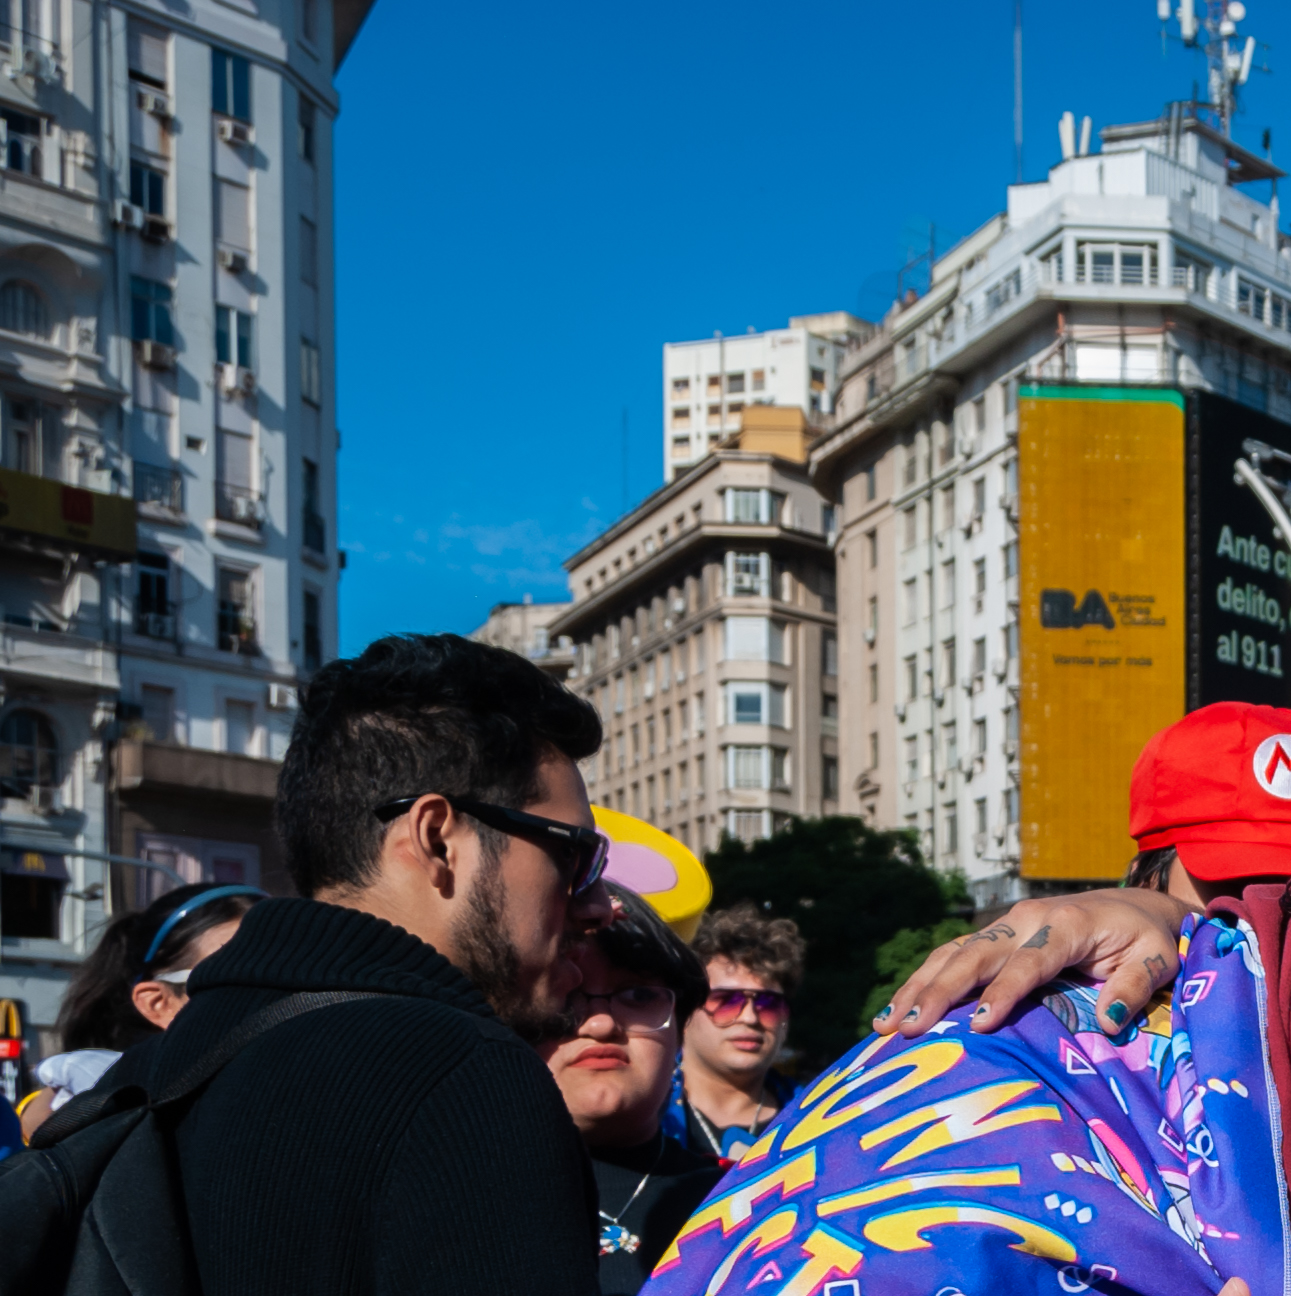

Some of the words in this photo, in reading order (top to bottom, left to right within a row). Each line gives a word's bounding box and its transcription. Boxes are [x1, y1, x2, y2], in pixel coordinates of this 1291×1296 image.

[1216, 524, 1270, 571] Ante
[1216, 575, 1287, 632] delito,
[1216, 630, 1239, 664] al
[1241, 635, 1283, 678] 911
